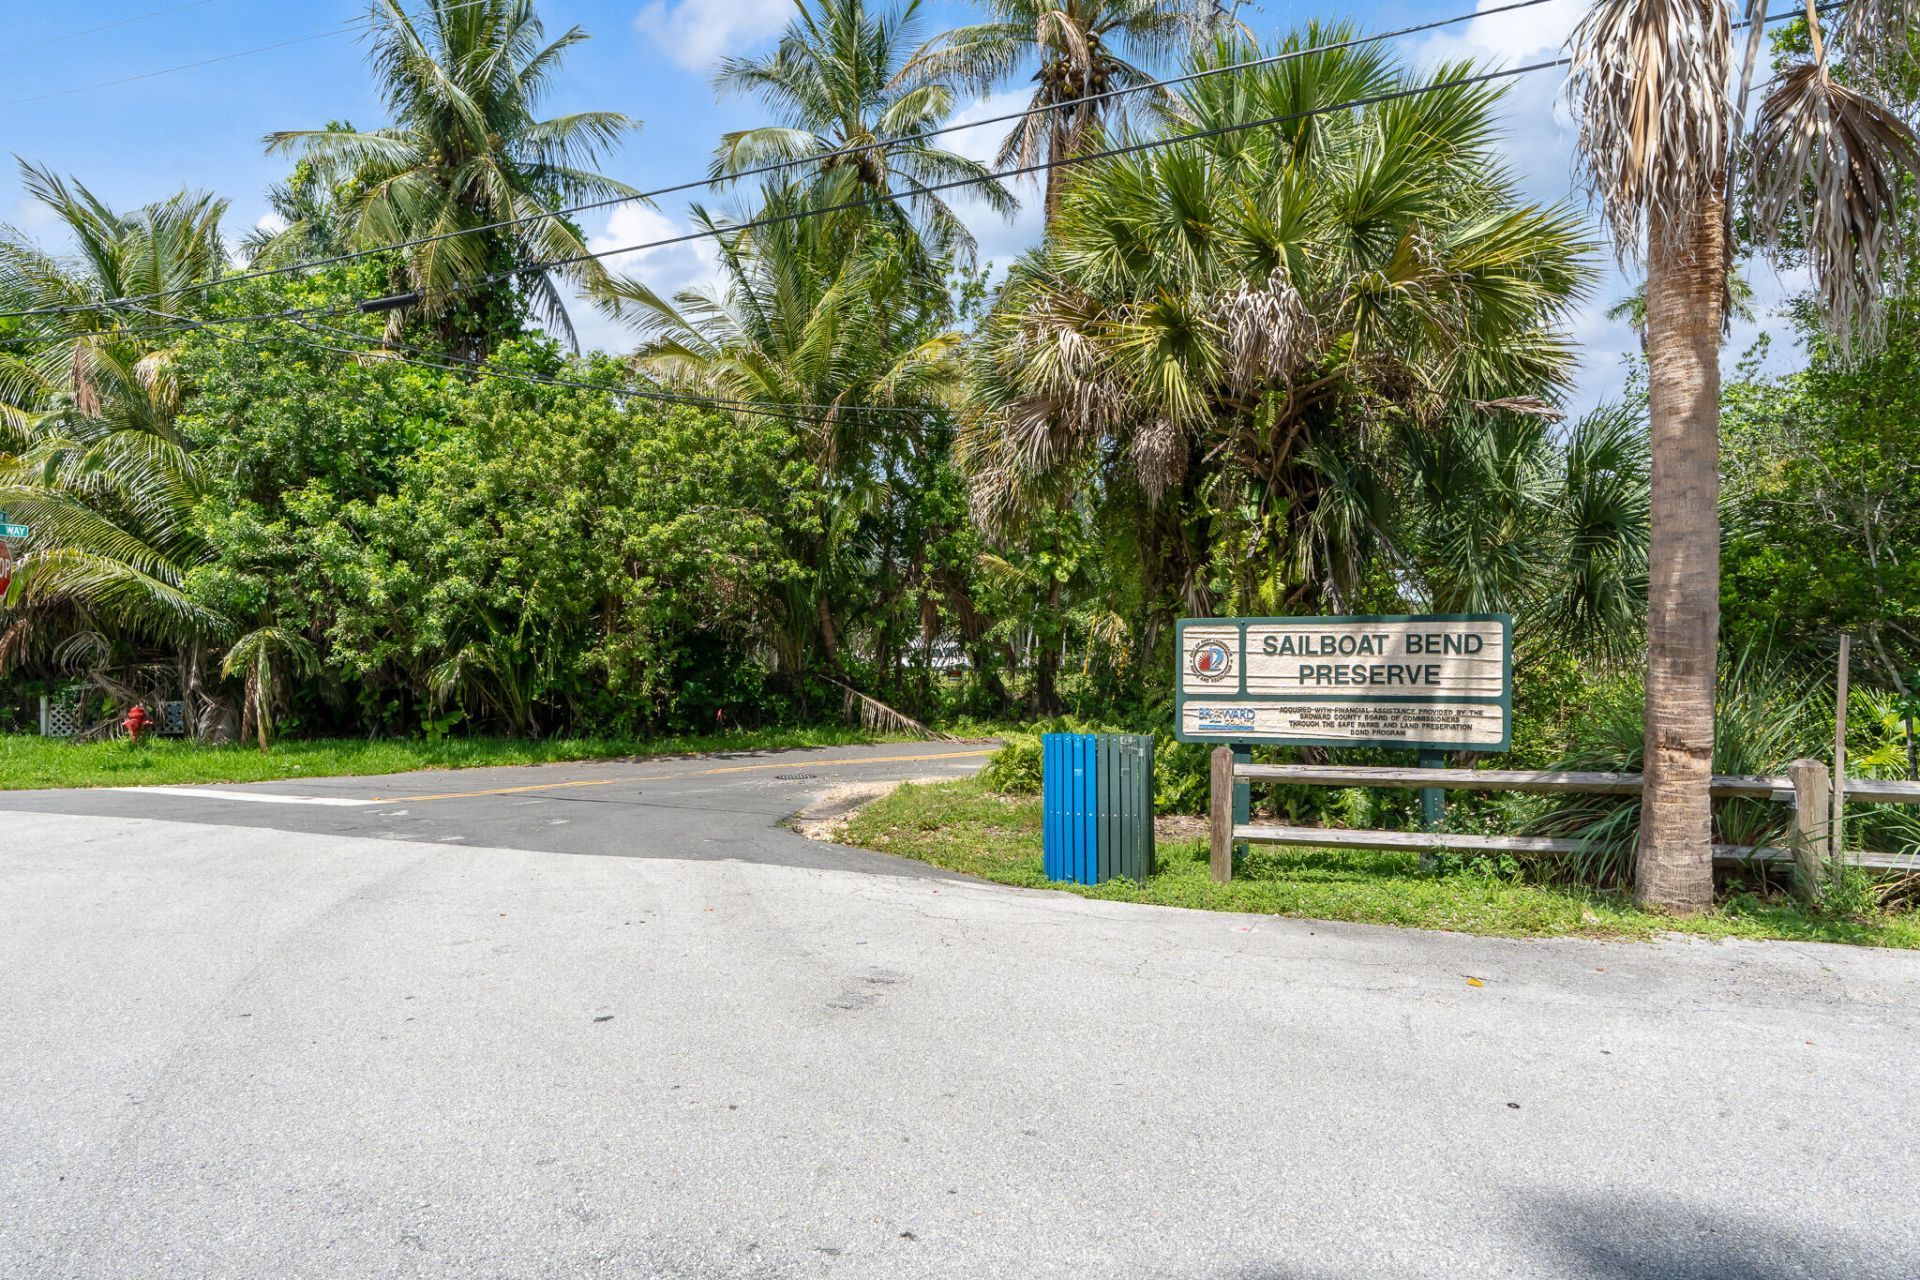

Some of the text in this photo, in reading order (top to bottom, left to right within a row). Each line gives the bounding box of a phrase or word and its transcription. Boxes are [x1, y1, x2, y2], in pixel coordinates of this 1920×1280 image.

[6, 527, 25, 536] WAY
[0, 558, 10, 578] OP
[1263, 634, 1483, 655] SAILBOAT BEND
[1300, 665, 1441, 685] PRESERVE
[1199, 707, 1255, 720] BROWARD
[1279, 706, 1312, 714] ACQUIRED
[1373, 707, 1416, 715] ASSISTANCE
[1418, 708, 1453, 716] PROVIDED
[1300, 713, 1331, 721] BROWARD
[1333, 713, 1361, 721] COUNTY
[1364, 713, 1388, 721] BOARD
[1402, 714, 1461, 723] COMMISSIONERS
[1288, 720, 1319, 728] THROUGH
[1383, 721, 1398, 729] AND
[1421, 723, 1473, 731] PRESERVATION
